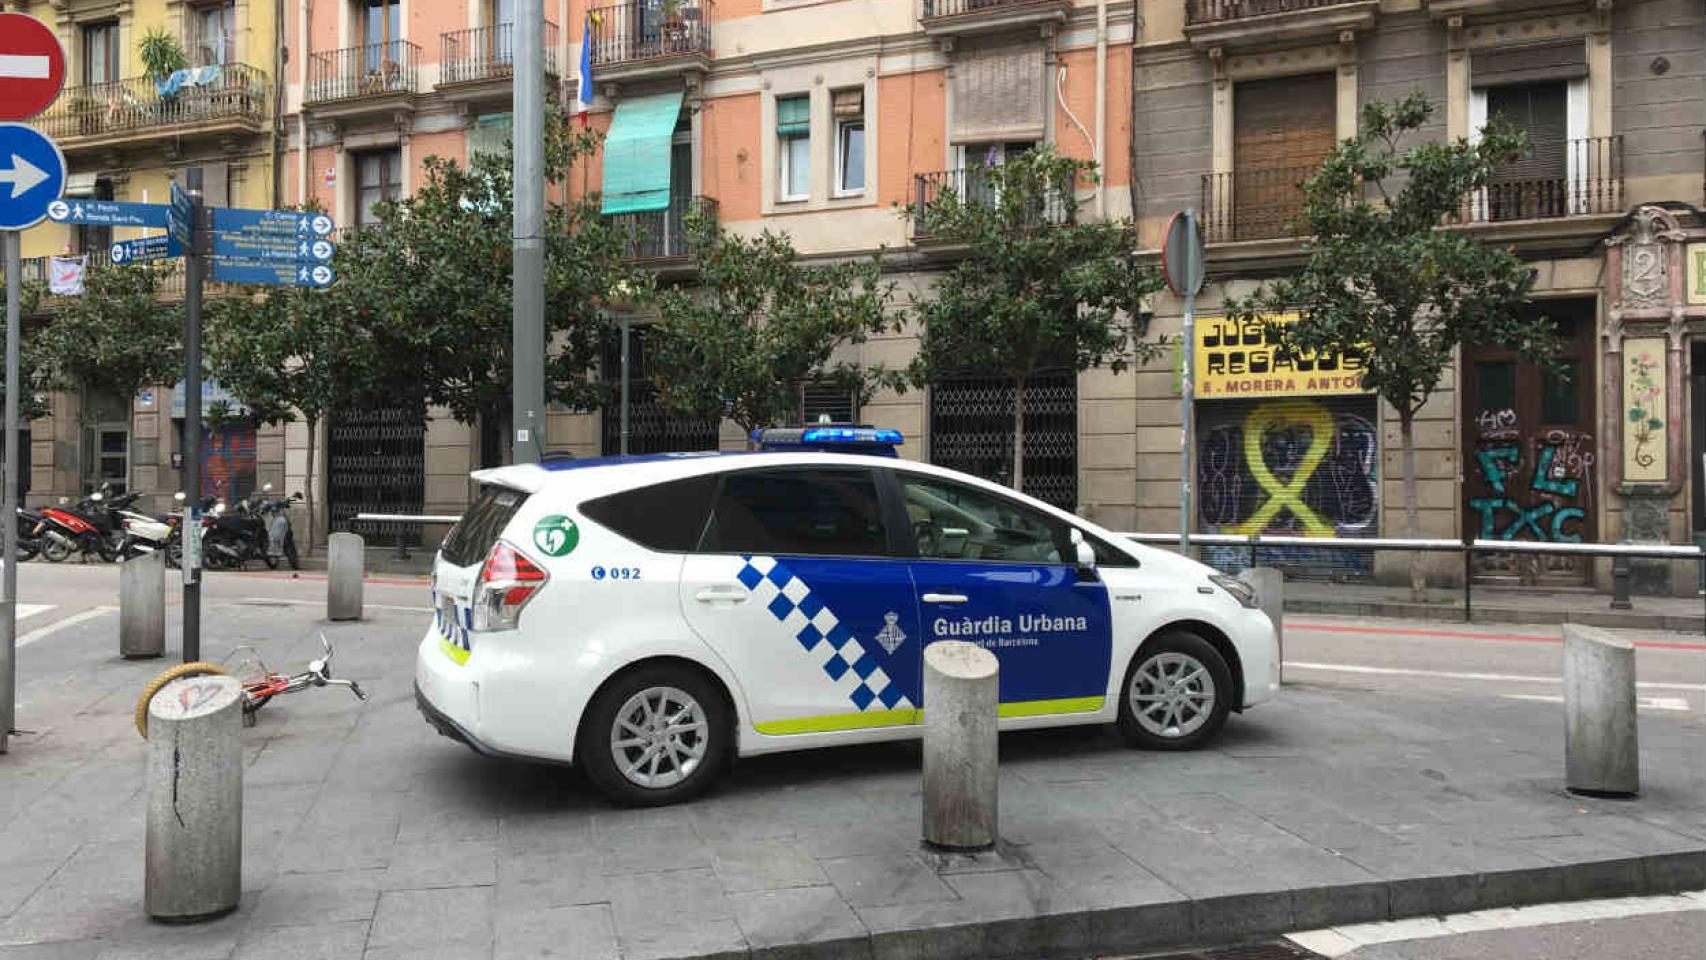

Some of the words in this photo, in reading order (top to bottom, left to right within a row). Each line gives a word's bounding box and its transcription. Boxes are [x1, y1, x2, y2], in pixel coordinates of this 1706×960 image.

[1635, 251, 1656, 281] 2
[1226, 378, 1296, 393] MORERA
[610, 567, 641, 580] 092
[933, 615, 1012, 636] Guàrdia
[1019, 613, 1088, 633] Urbana
[998, 636, 1038, 648] Barcelona
